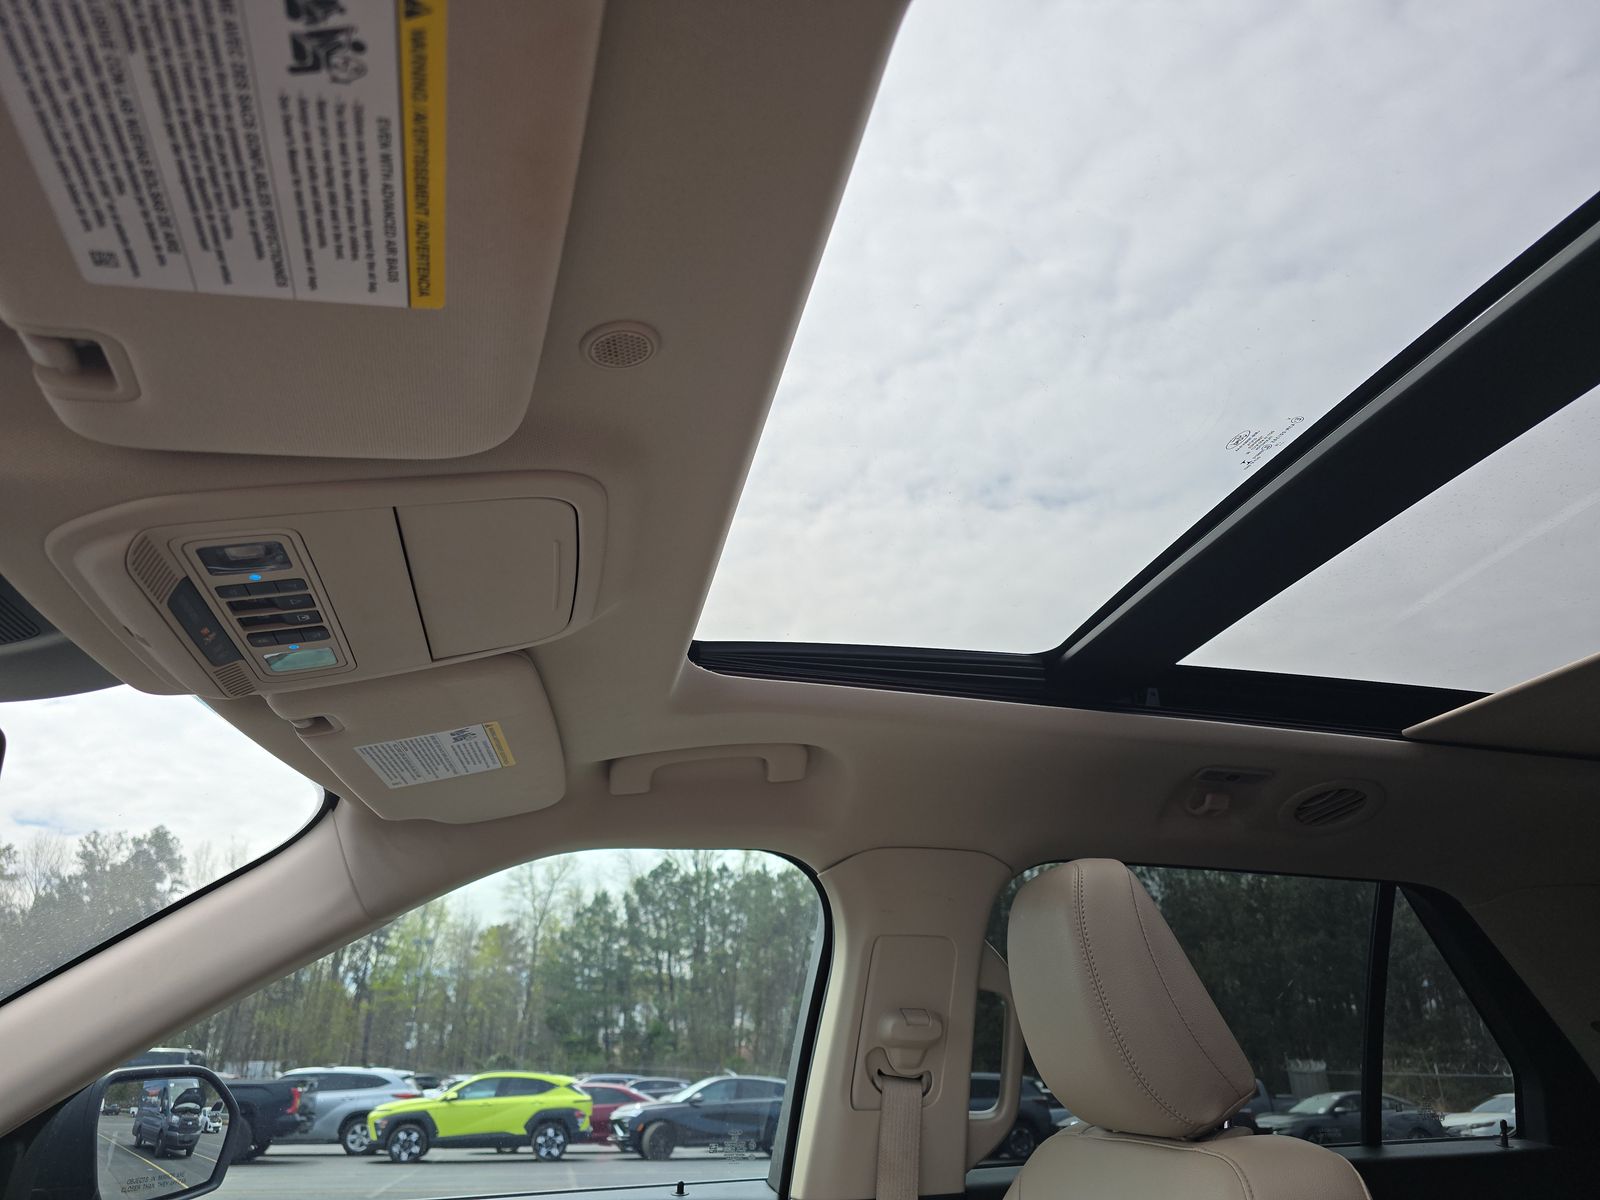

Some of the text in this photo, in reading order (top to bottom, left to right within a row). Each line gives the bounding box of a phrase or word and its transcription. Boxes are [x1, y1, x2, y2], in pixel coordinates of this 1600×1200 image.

[411, 28, 428, 101] WARNING
[378, 152, 392, 181] WITH
[381, 183, 396, 237] ADVANCED
[384, 240, 398, 256] AIR
